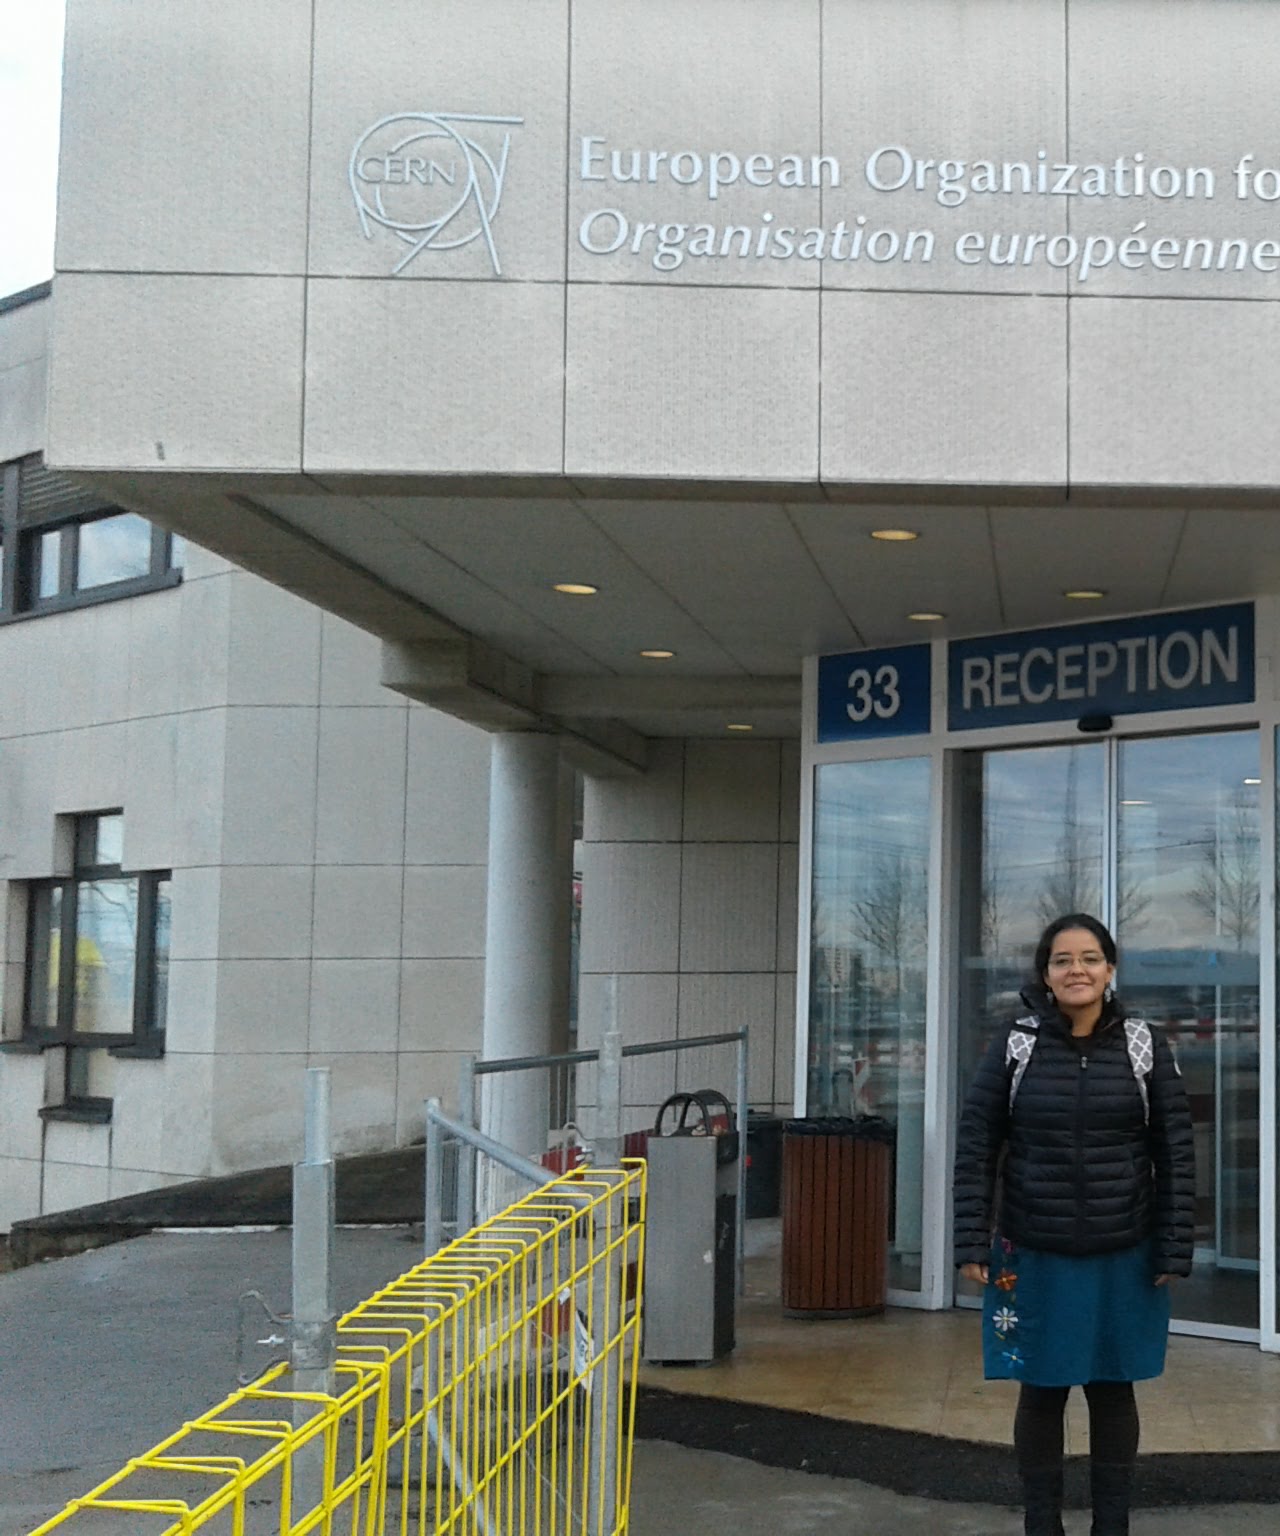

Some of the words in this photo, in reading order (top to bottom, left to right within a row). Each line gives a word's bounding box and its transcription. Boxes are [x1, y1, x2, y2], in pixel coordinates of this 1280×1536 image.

[356, 154, 456, 187] CERN
[580, 137, 841, 199] European
[866, 146, 1215, 209] Organization
[578, 208, 936, 271] Organisation
[845, 664, 902, 722] 33
[962, 627, 1238, 710] RECEPTION
